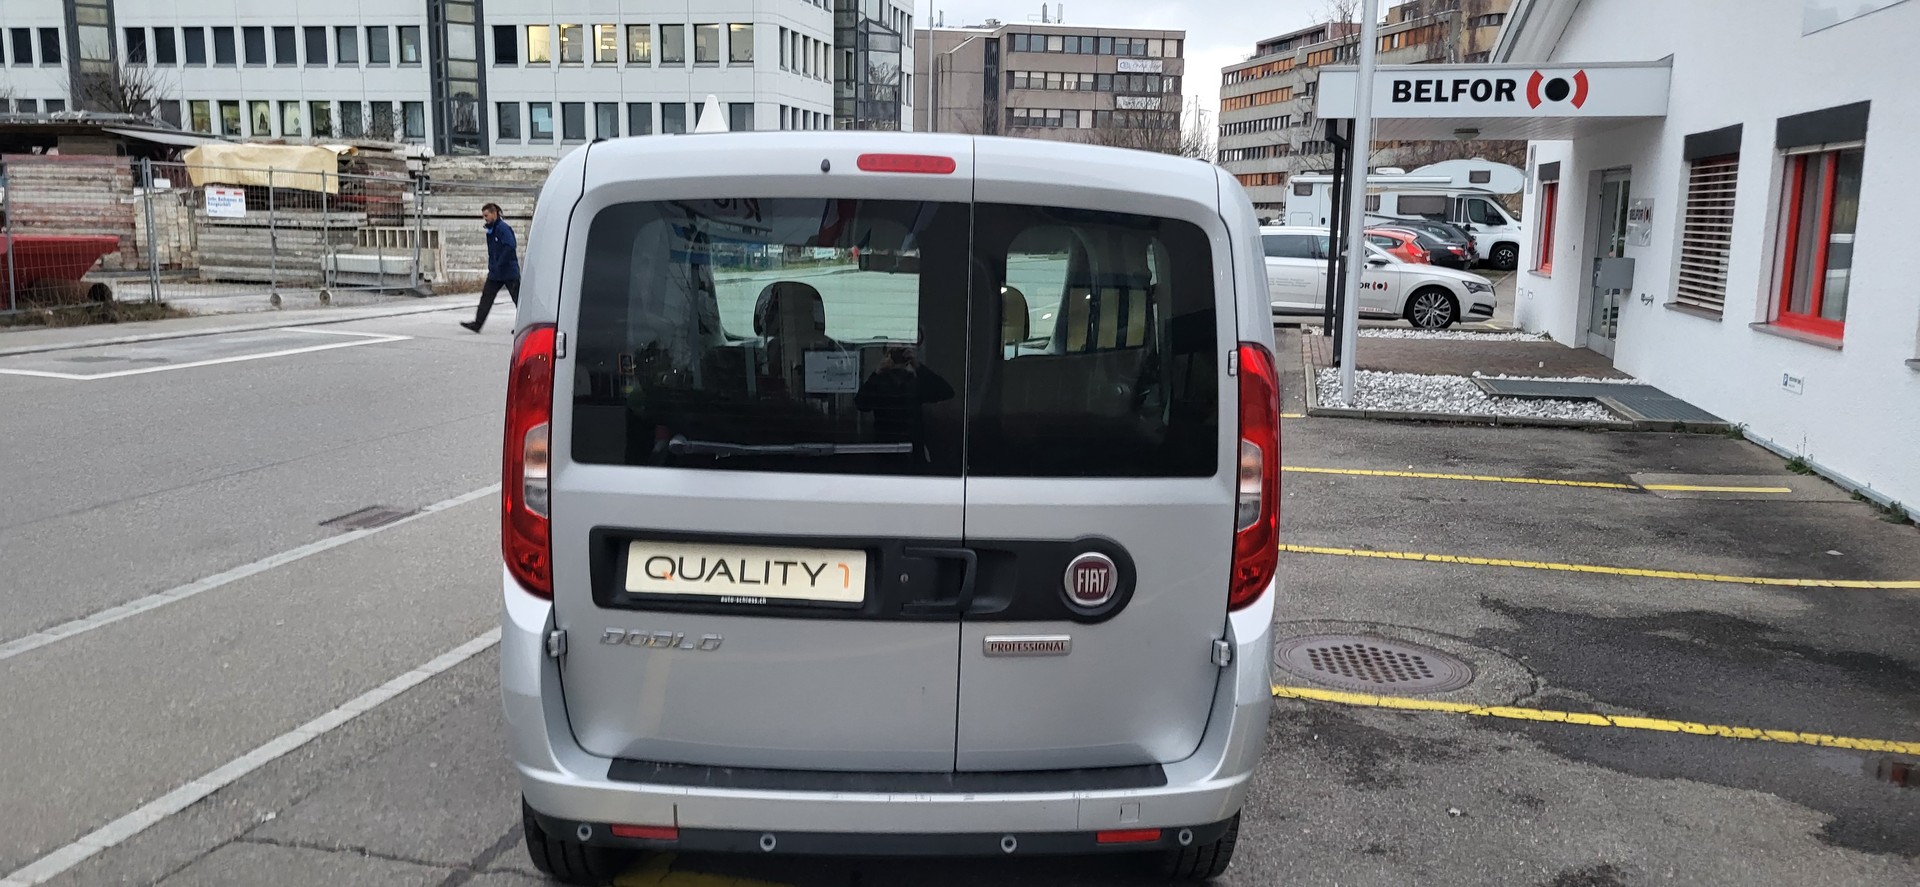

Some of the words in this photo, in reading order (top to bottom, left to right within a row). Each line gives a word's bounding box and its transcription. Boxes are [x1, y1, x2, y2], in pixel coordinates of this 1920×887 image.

[1391, 78, 1517, 103] BELFOR
[644, 555, 828, 587] QUALITY
[837, 562, 850, 589] 1
[1077, 567, 1108, 594] FIAT
[990, 641, 1066, 653] PROFESSIONAL
